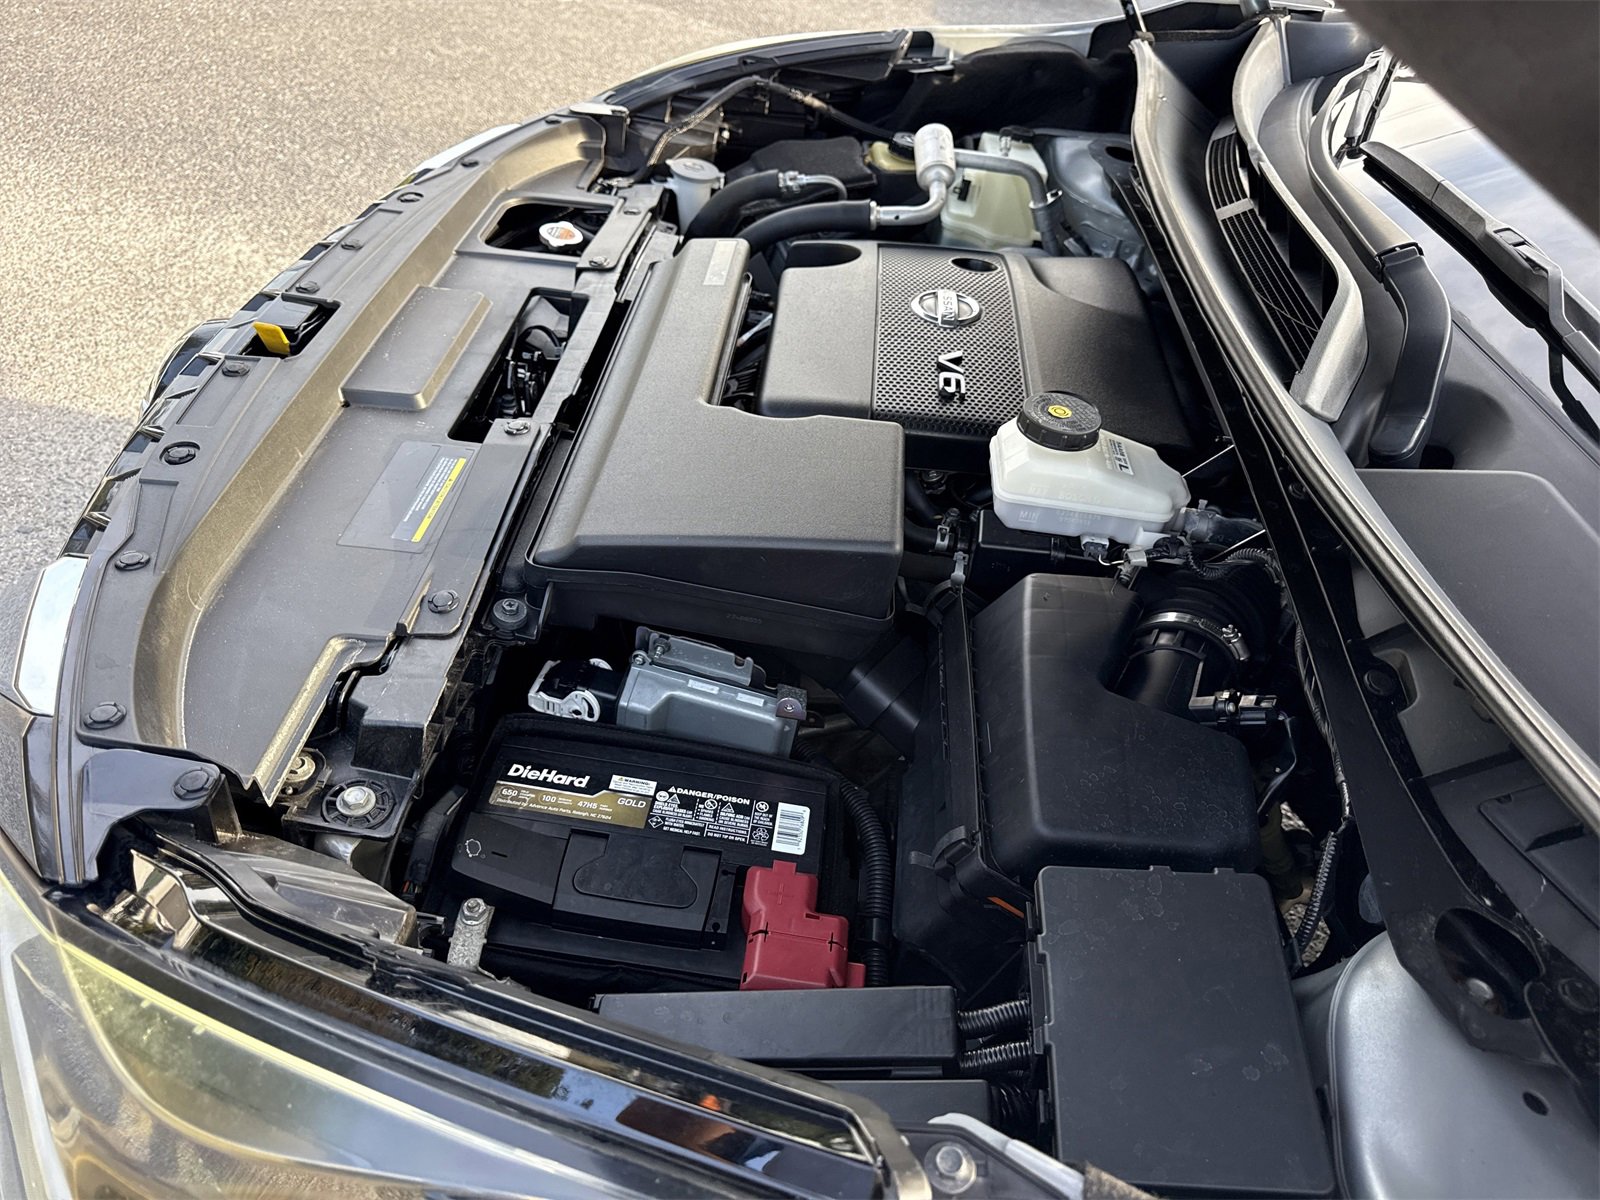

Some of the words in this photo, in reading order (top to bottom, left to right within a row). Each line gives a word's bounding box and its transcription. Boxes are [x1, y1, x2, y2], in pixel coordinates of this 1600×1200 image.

[938, 350, 966, 395] V6
[1019, 511, 1040, 520] MIN
[507, 763, 591, 788] DieHard
[501, 788, 518, 796] 650
[676, 787, 750, 805] DANGER/POISON
[542, 794, 556, 803] 100
[617, 797, 647, 808] GOLD
[577, 800, 598, 809] 47H5
